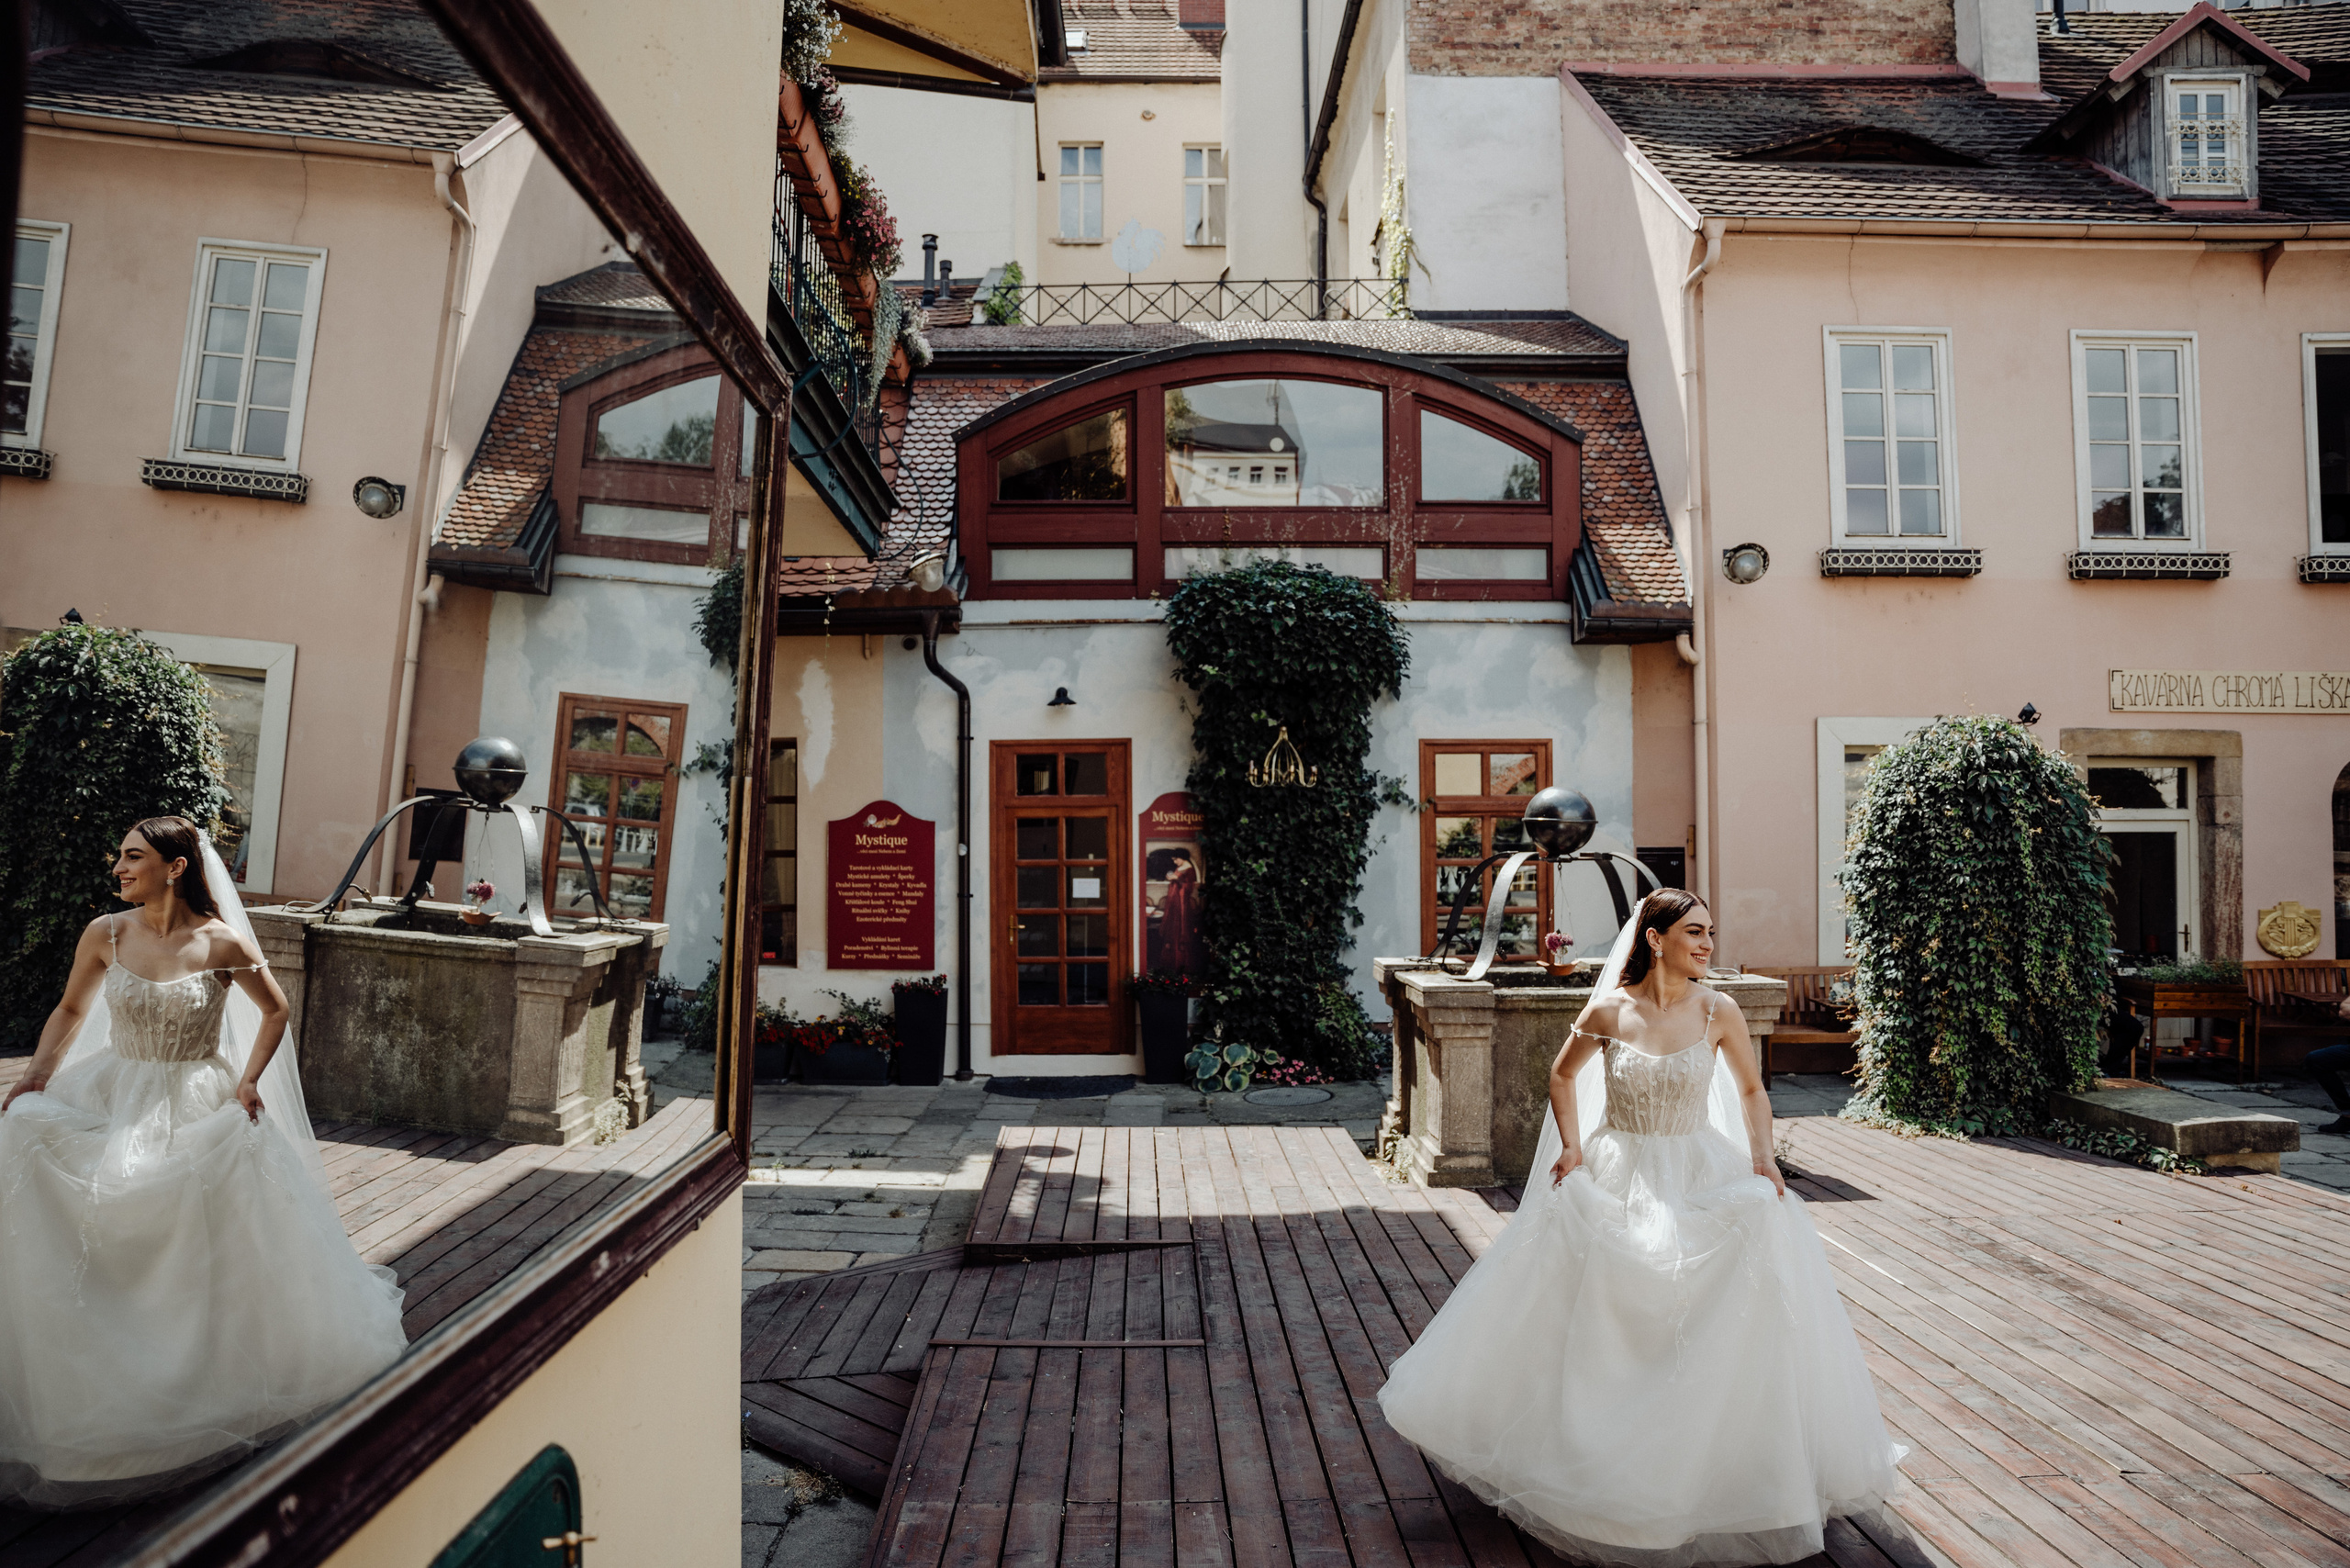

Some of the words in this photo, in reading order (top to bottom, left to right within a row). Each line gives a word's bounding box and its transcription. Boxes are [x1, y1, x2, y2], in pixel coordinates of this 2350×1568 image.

[2121, 673, 2204, 707] KAVÁRNA
[2212, 673, 2285, 708] CHROMÁ
[1152, 811, 1204, 824] Mystique
[855, 834, 908, 848] Mystique
[897, 872, 915, 880] Šperky
